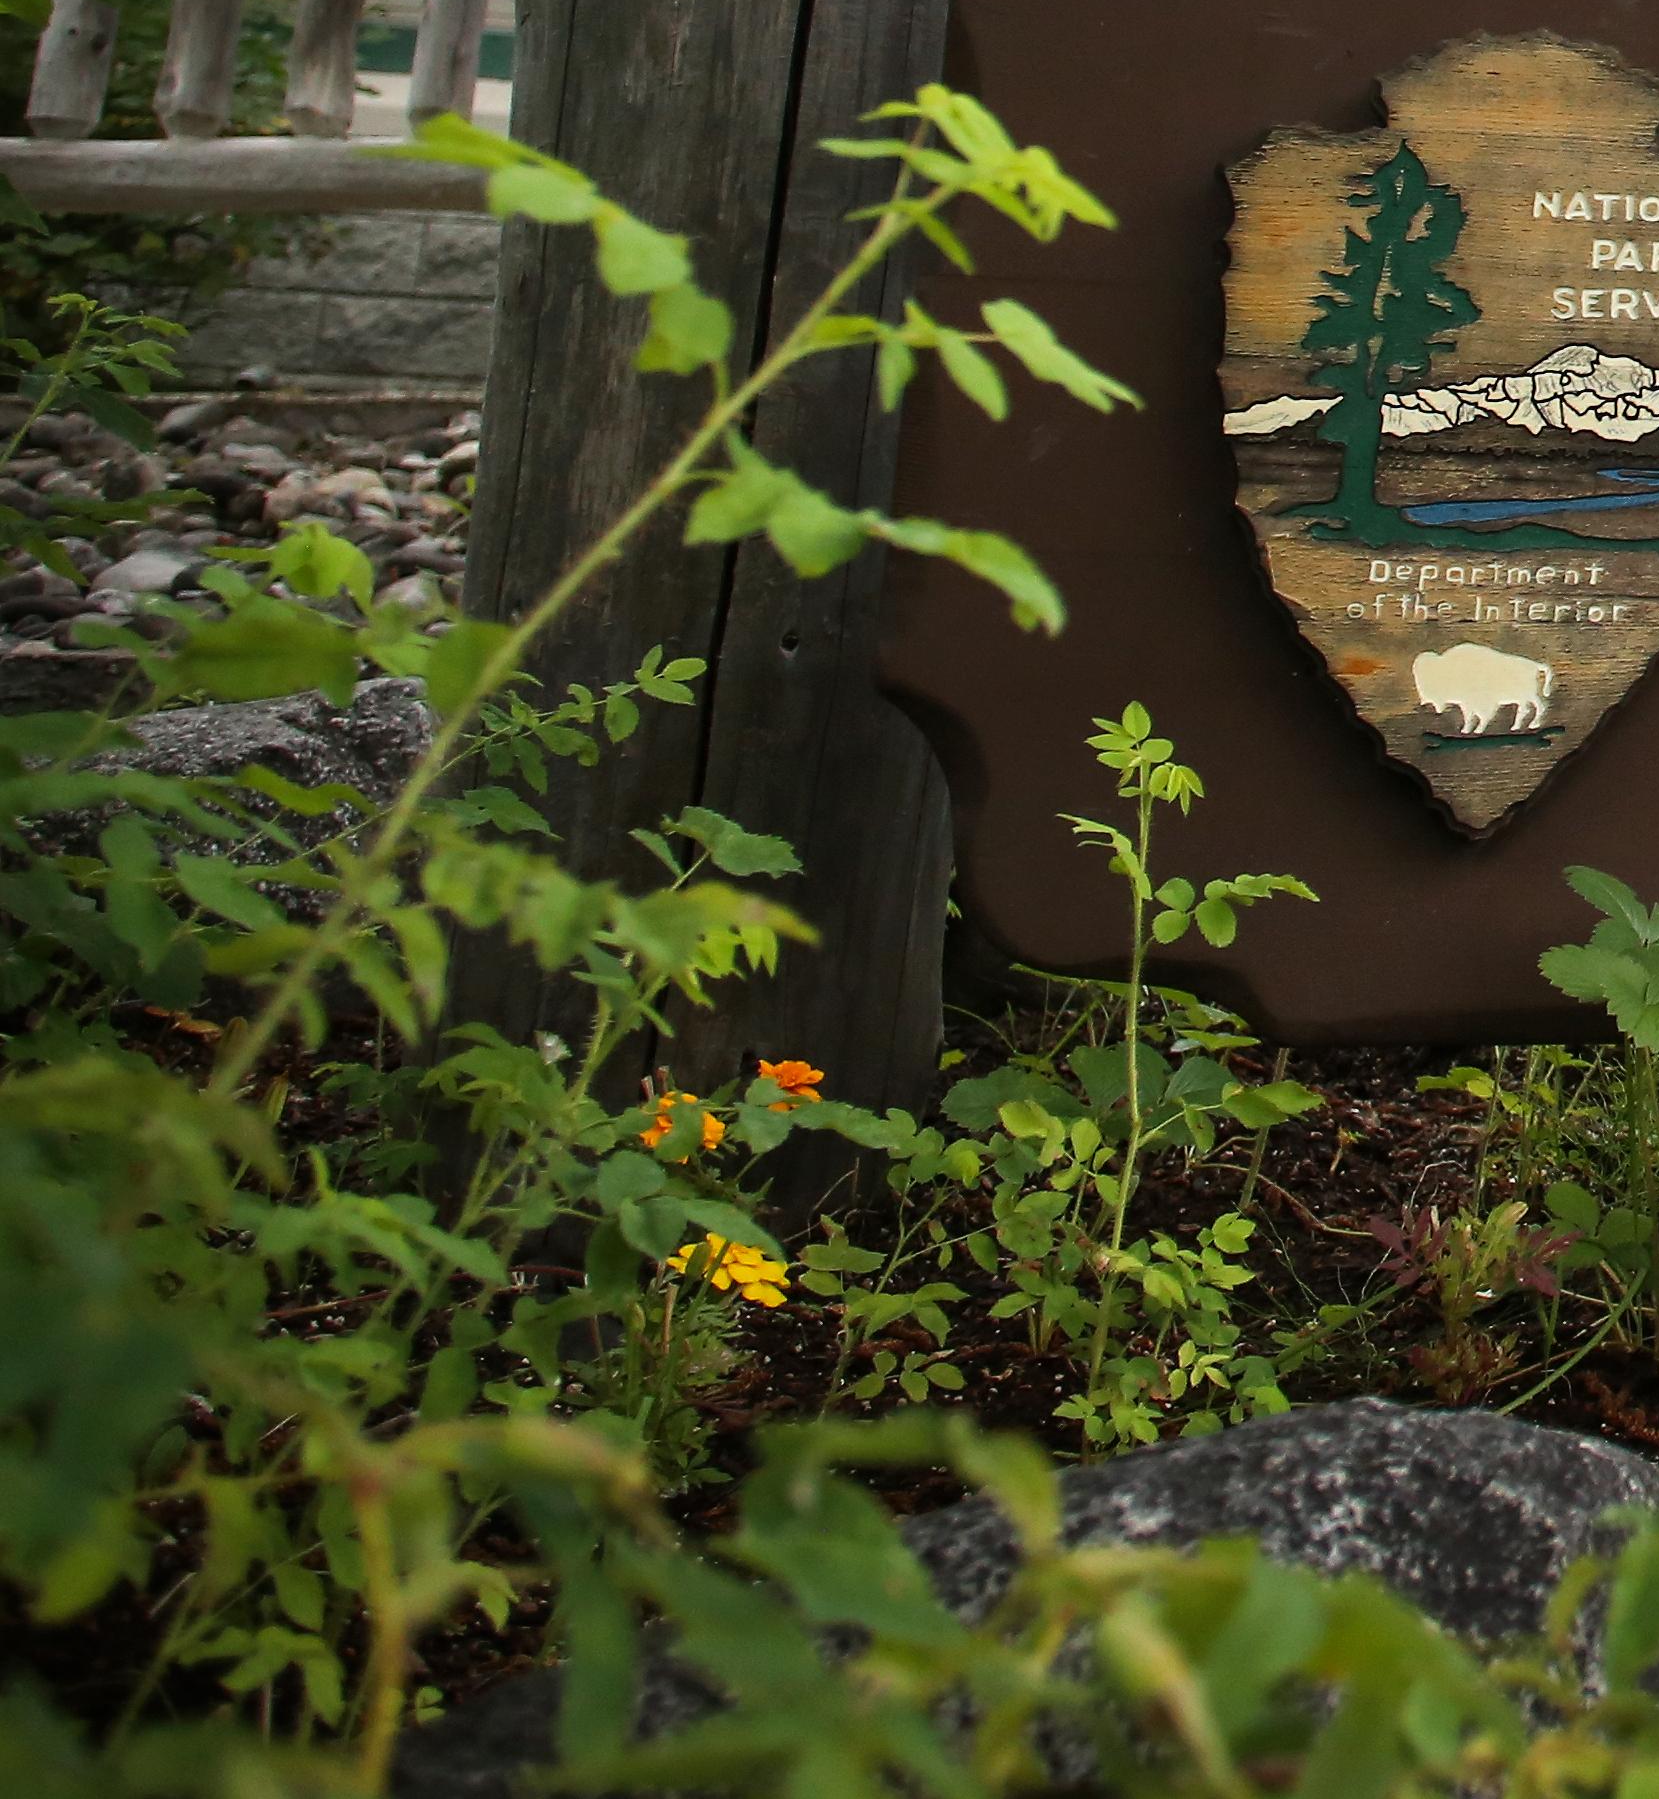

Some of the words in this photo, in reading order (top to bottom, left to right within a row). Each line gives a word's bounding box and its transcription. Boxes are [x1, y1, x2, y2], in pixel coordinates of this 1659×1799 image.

[1368, 559, 1605, 591] Department
[1346, 594, 1387, 620] of
[1395, 593, 1455, 621] the
[1474, 595, 1629, 623] Interior
